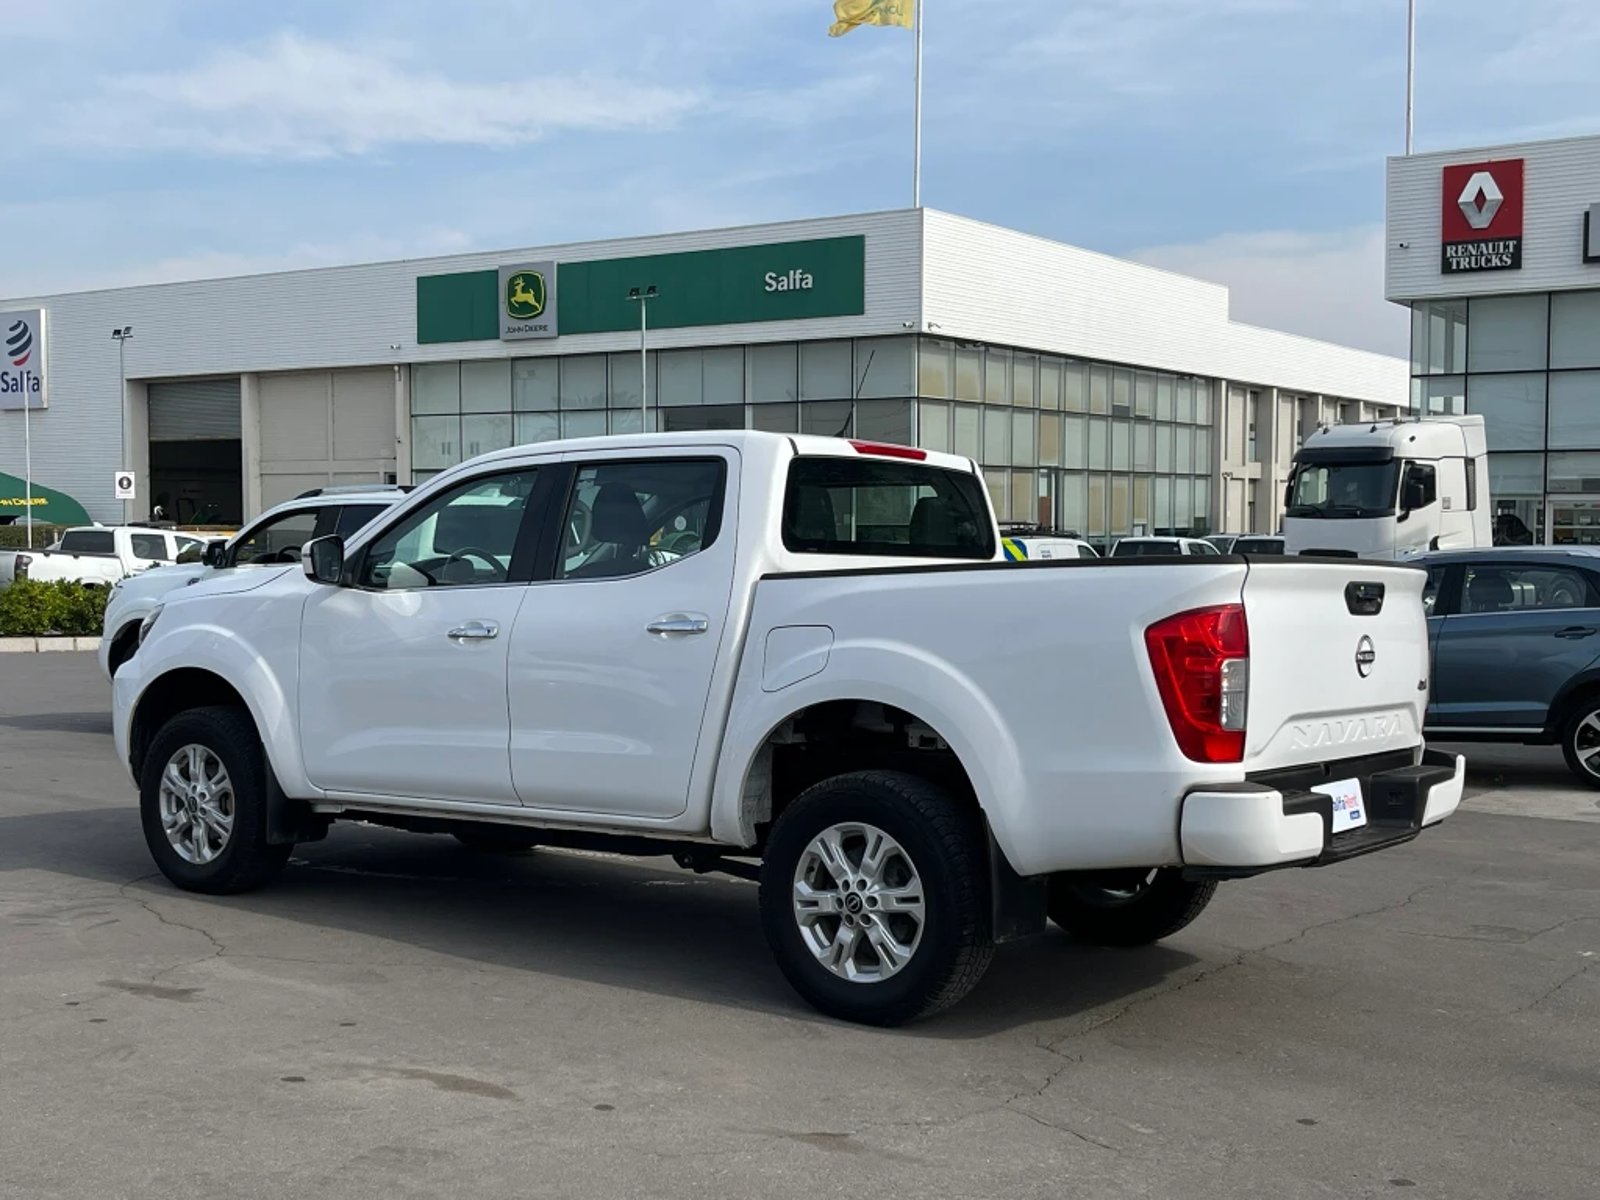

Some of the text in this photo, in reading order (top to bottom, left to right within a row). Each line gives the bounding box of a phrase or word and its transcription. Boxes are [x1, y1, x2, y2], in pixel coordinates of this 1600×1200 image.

[1446, 240, 1517, 258] RENAULT
[1449, 254, 1512, 270] TRUCKS
[764, 269, 813, 292] Salfa
[506, 324, 549, 334] JOHN DEERE
[1, 370, 41, 393] Salfa
[1291, 714, 1403, 750] NAVARA
